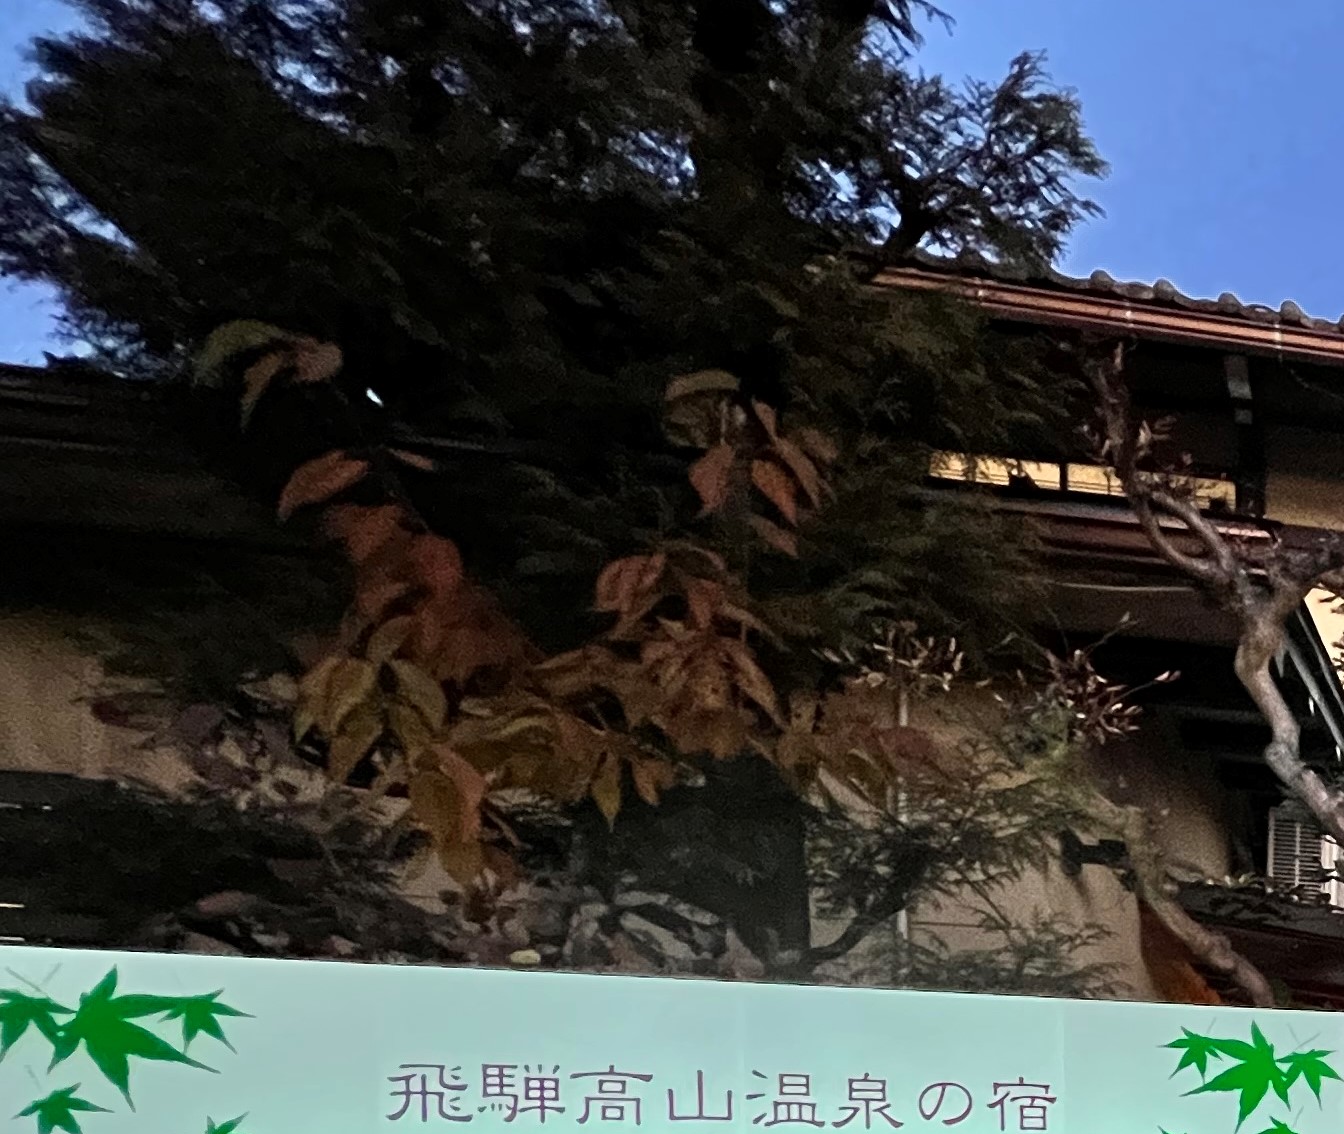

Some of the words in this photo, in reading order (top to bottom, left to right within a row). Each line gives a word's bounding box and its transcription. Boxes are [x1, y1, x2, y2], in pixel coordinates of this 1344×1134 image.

[386, 1063, 1058, 1132] 飛騨高山温泉の宿
